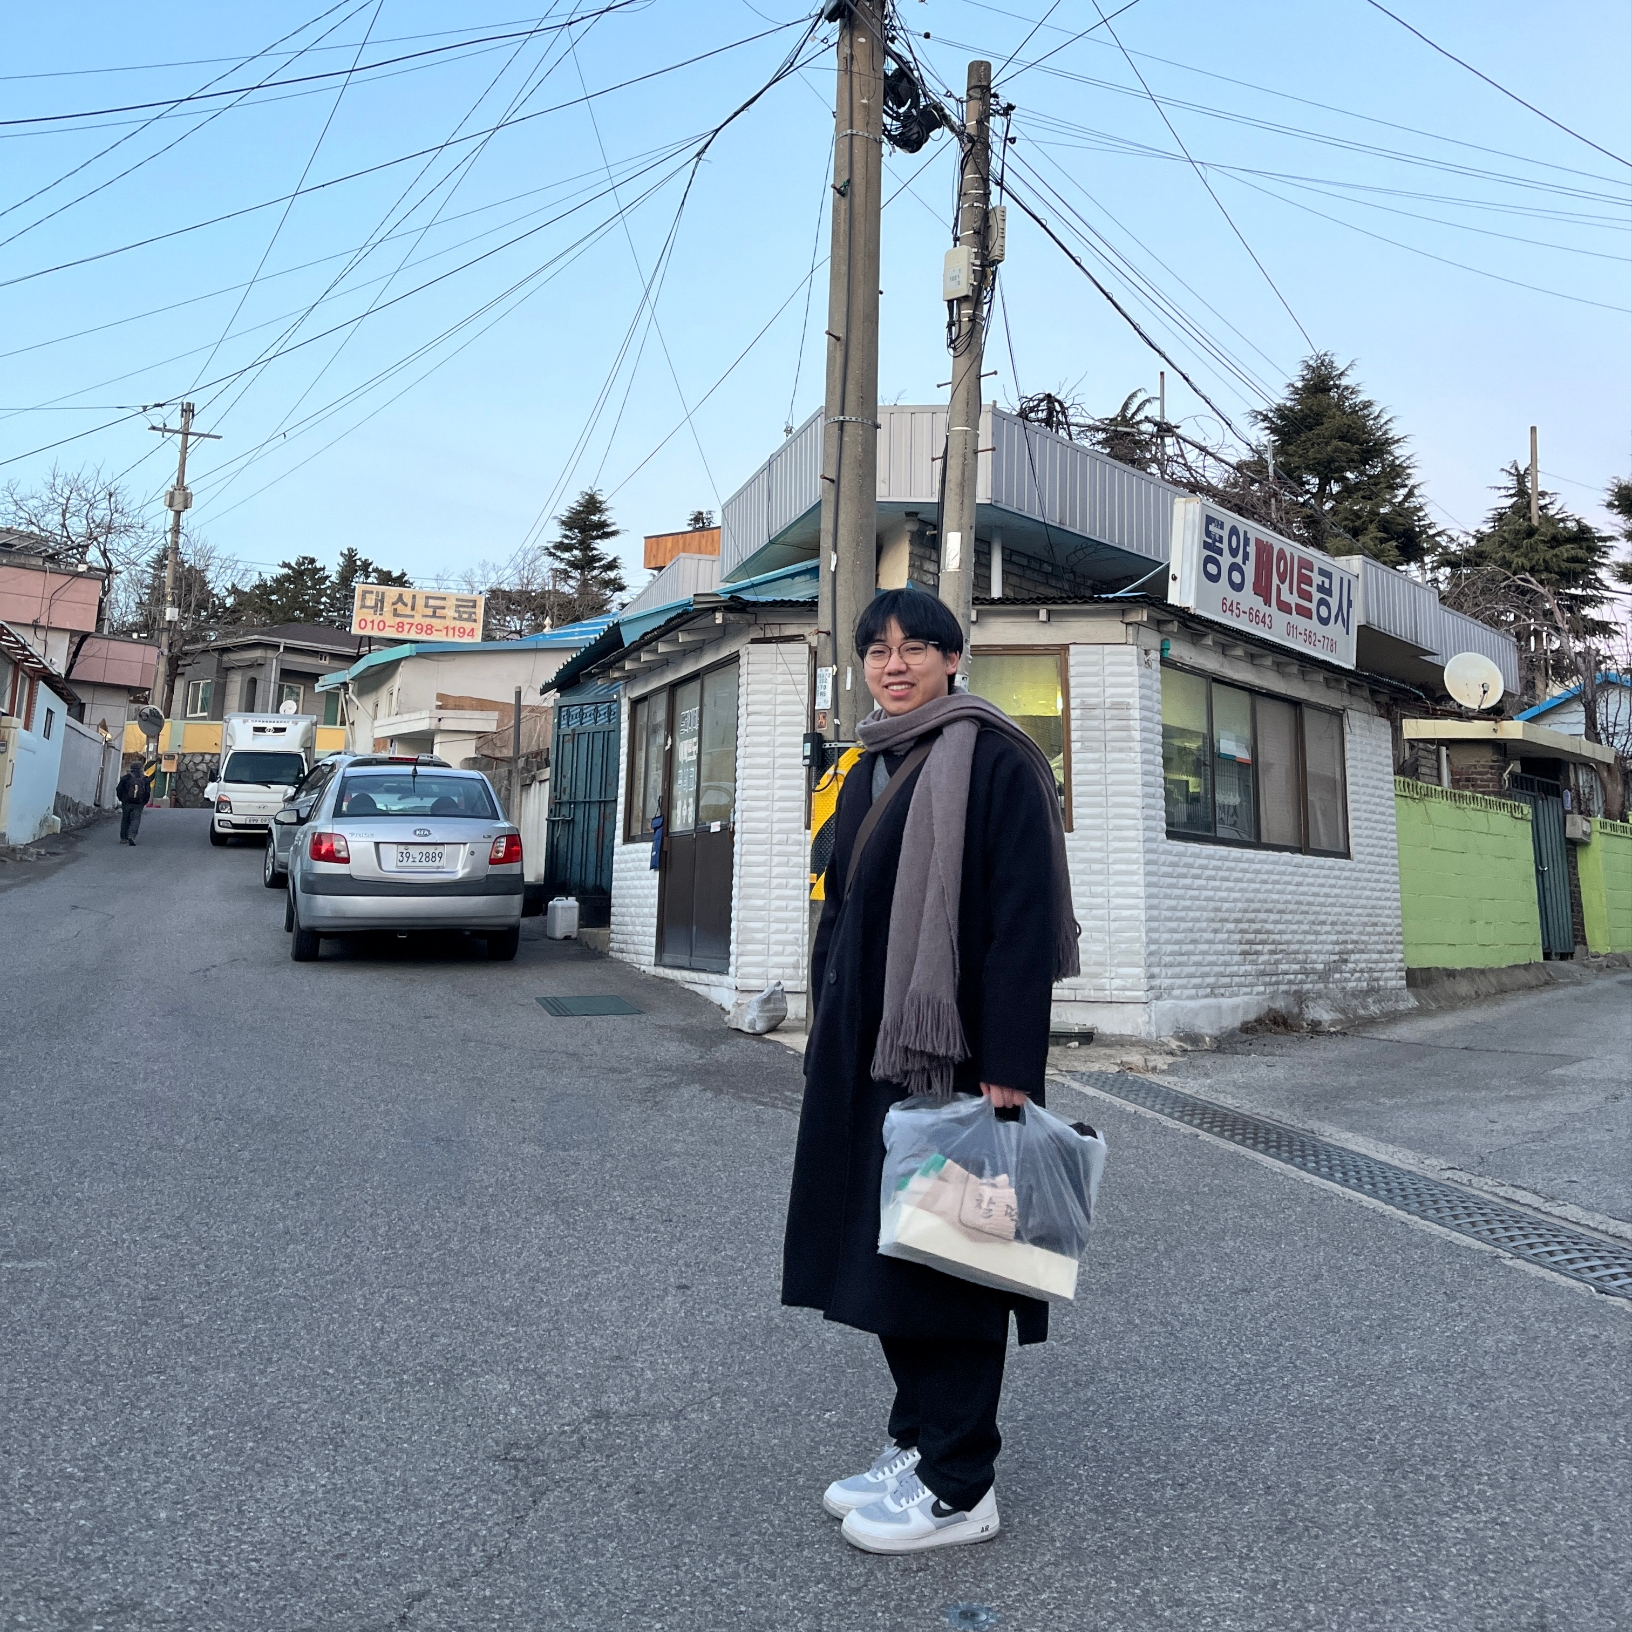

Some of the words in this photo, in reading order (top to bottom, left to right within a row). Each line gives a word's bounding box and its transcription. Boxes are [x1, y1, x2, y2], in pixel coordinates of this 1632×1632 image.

[359, 589, 478, 624] 대신도료
[1221, 596, 1273, 630] 645-6643
[358, 618, 475, 639] 010-8798-1194
[1286, 621, 1338, 654] 011-562-7781
[414, 828, 432, 836] KIA
[398, 851, 444, 863] 39노2889
[980, 1525, 990, 1533] AIR
